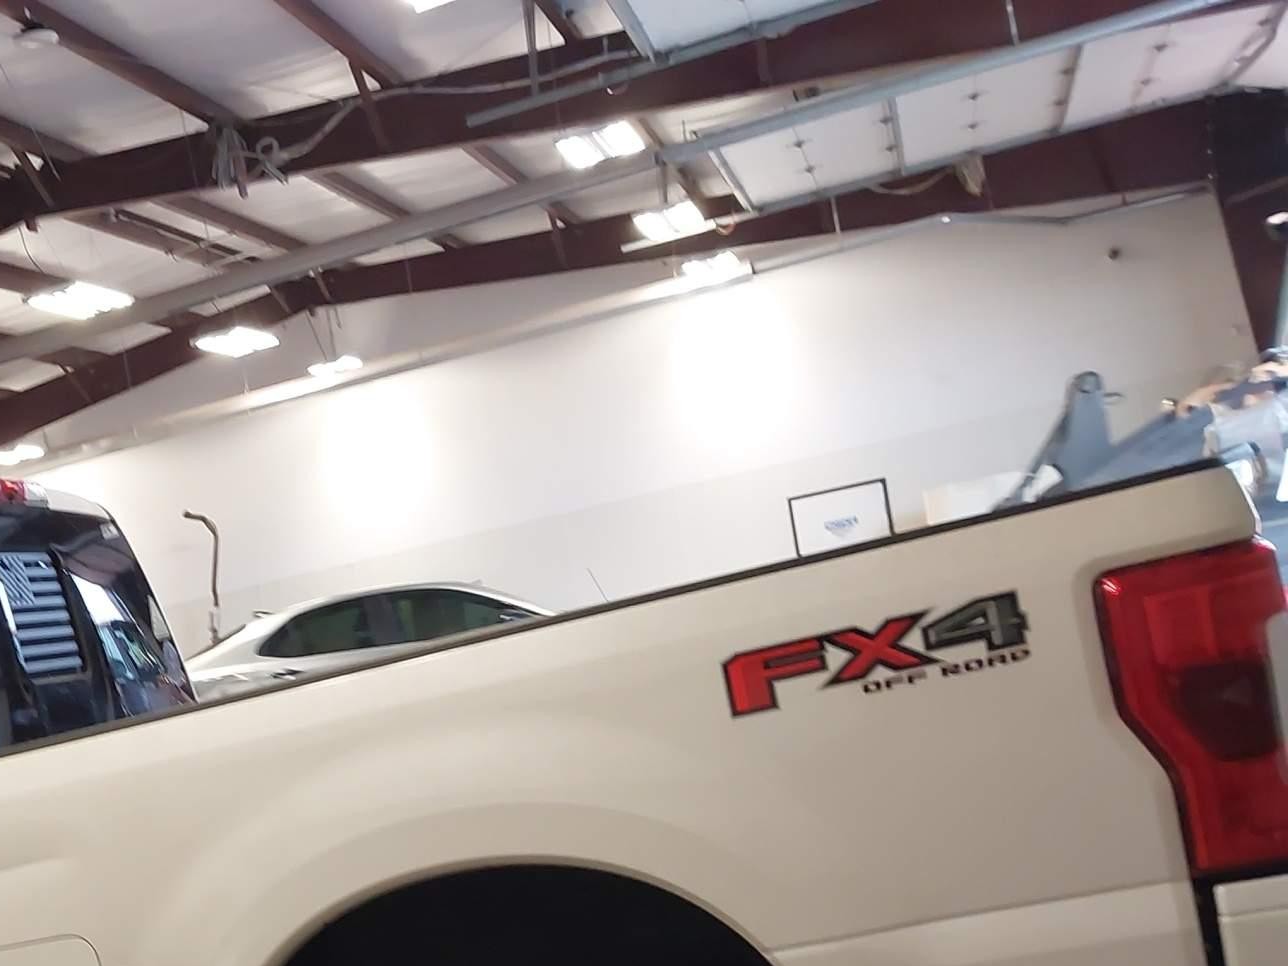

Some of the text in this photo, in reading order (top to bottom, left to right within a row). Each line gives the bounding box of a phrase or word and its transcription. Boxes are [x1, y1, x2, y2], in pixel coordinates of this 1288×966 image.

[722, 591, 1029, 718] FX4
[863, 649, 1030, 694] OFF ROAD
